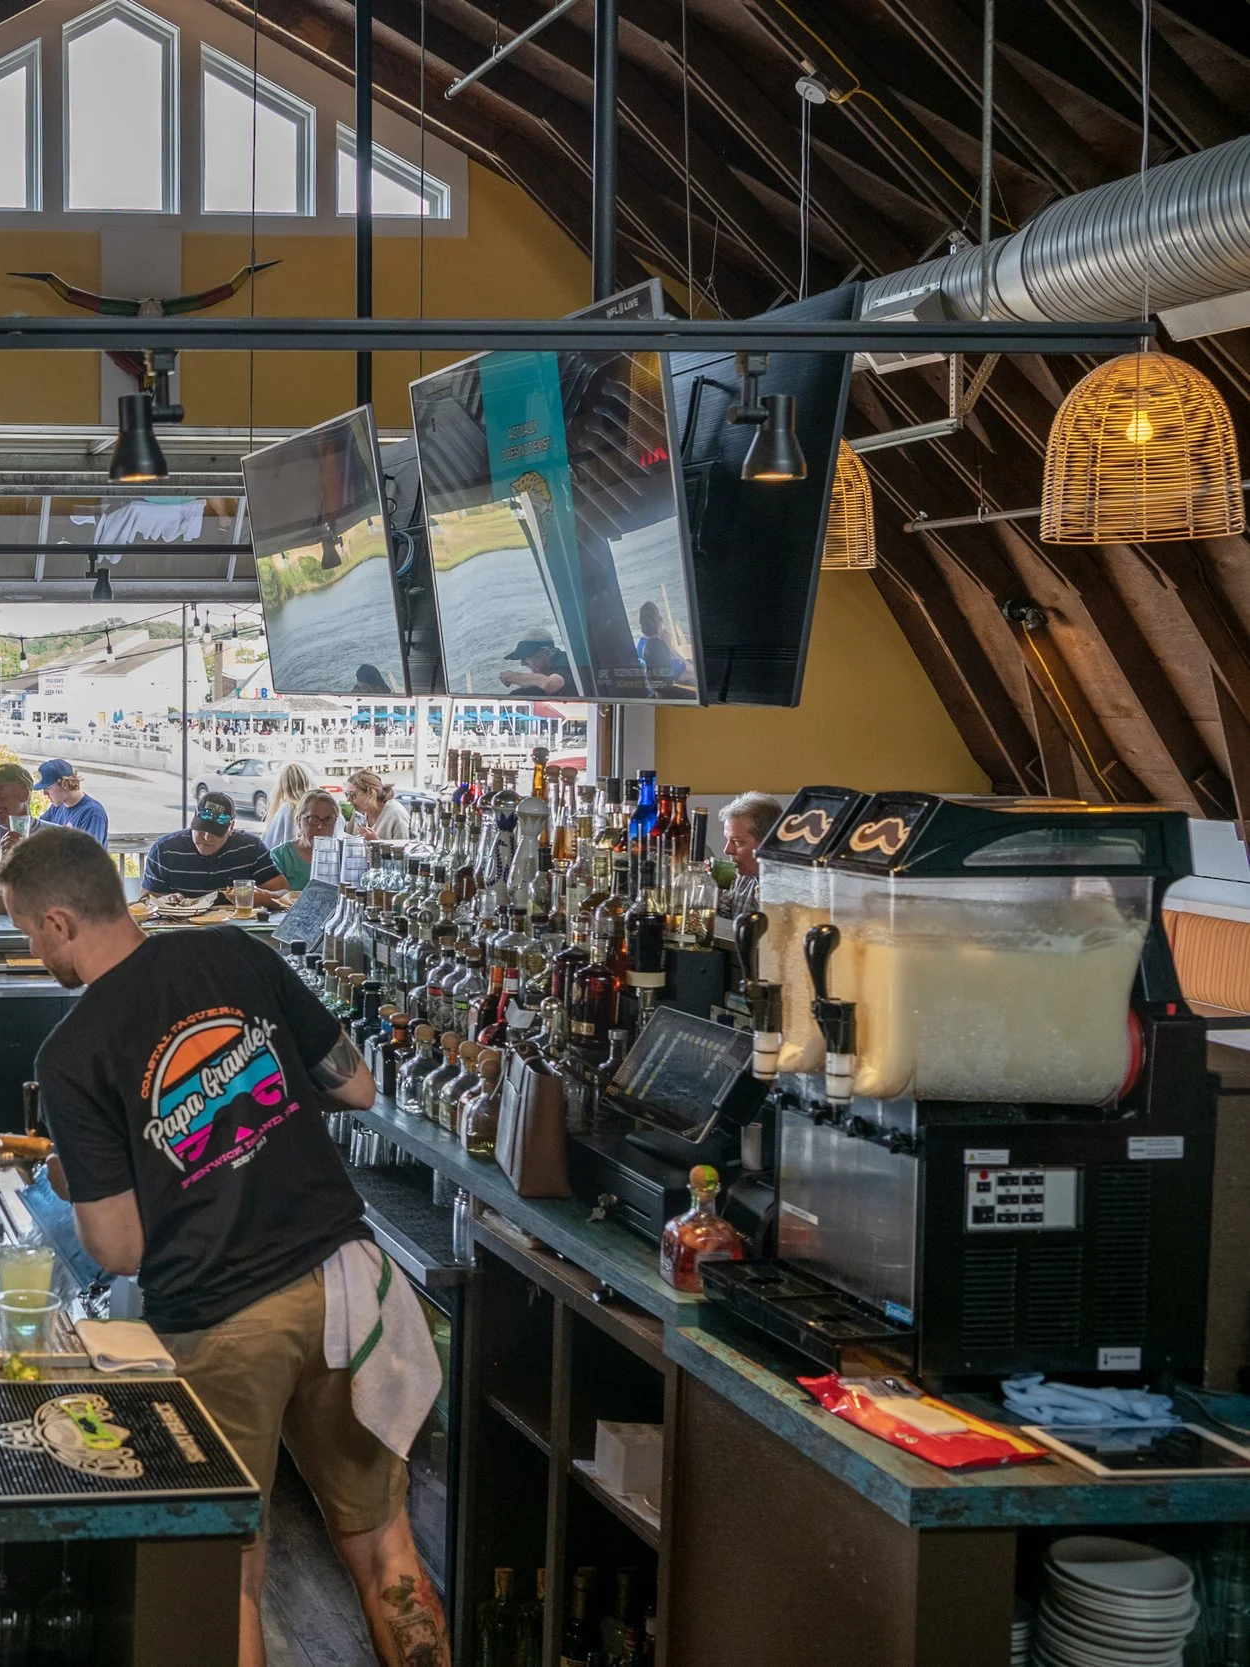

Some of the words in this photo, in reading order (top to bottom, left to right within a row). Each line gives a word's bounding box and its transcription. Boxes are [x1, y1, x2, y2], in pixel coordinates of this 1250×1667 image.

[606, 305, 619, 319] NFL
[623, 297, 639, 311] LIVE
[141, 1034, 172, 1099] COASTAL
[170, 1006, 246, 1034] TAQUERIA
[143, 1093, 205, 1150] Papa
[201, 1016, 278, 1099] Grande's
[181, 1145, 244, 1189] FENWICK
